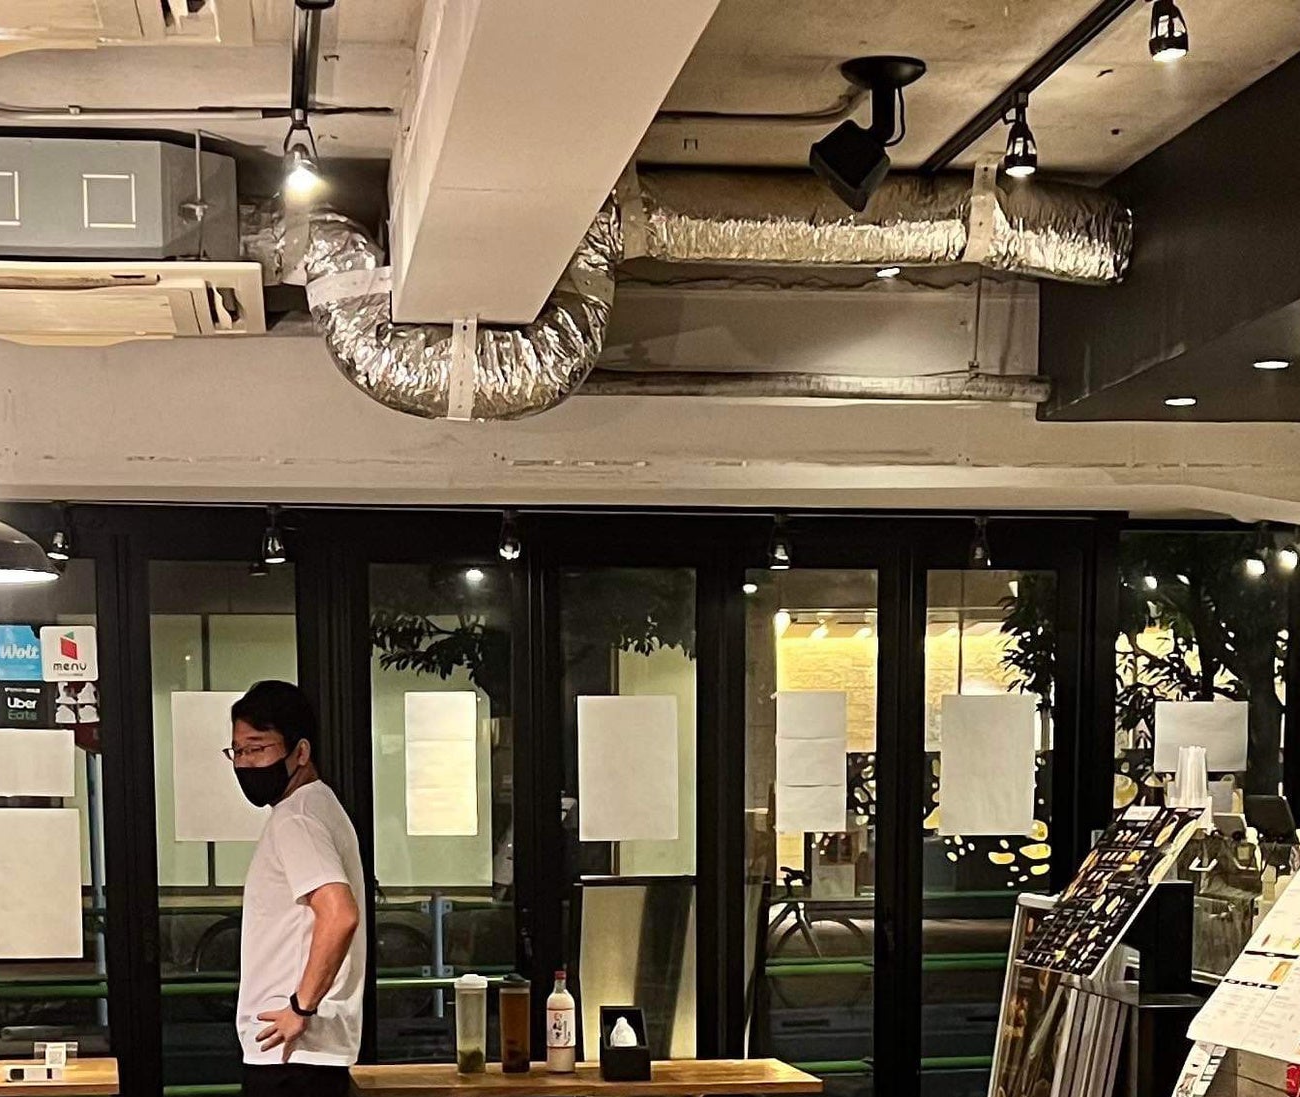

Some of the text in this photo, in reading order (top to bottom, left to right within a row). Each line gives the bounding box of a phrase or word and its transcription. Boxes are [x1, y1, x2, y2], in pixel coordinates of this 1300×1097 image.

[1, 644, 39, 659] Wolt
[53, 662, 87, 671] menu
[7, 697, 37, 709] Uber
[8, 710, 37, 721] Eats
